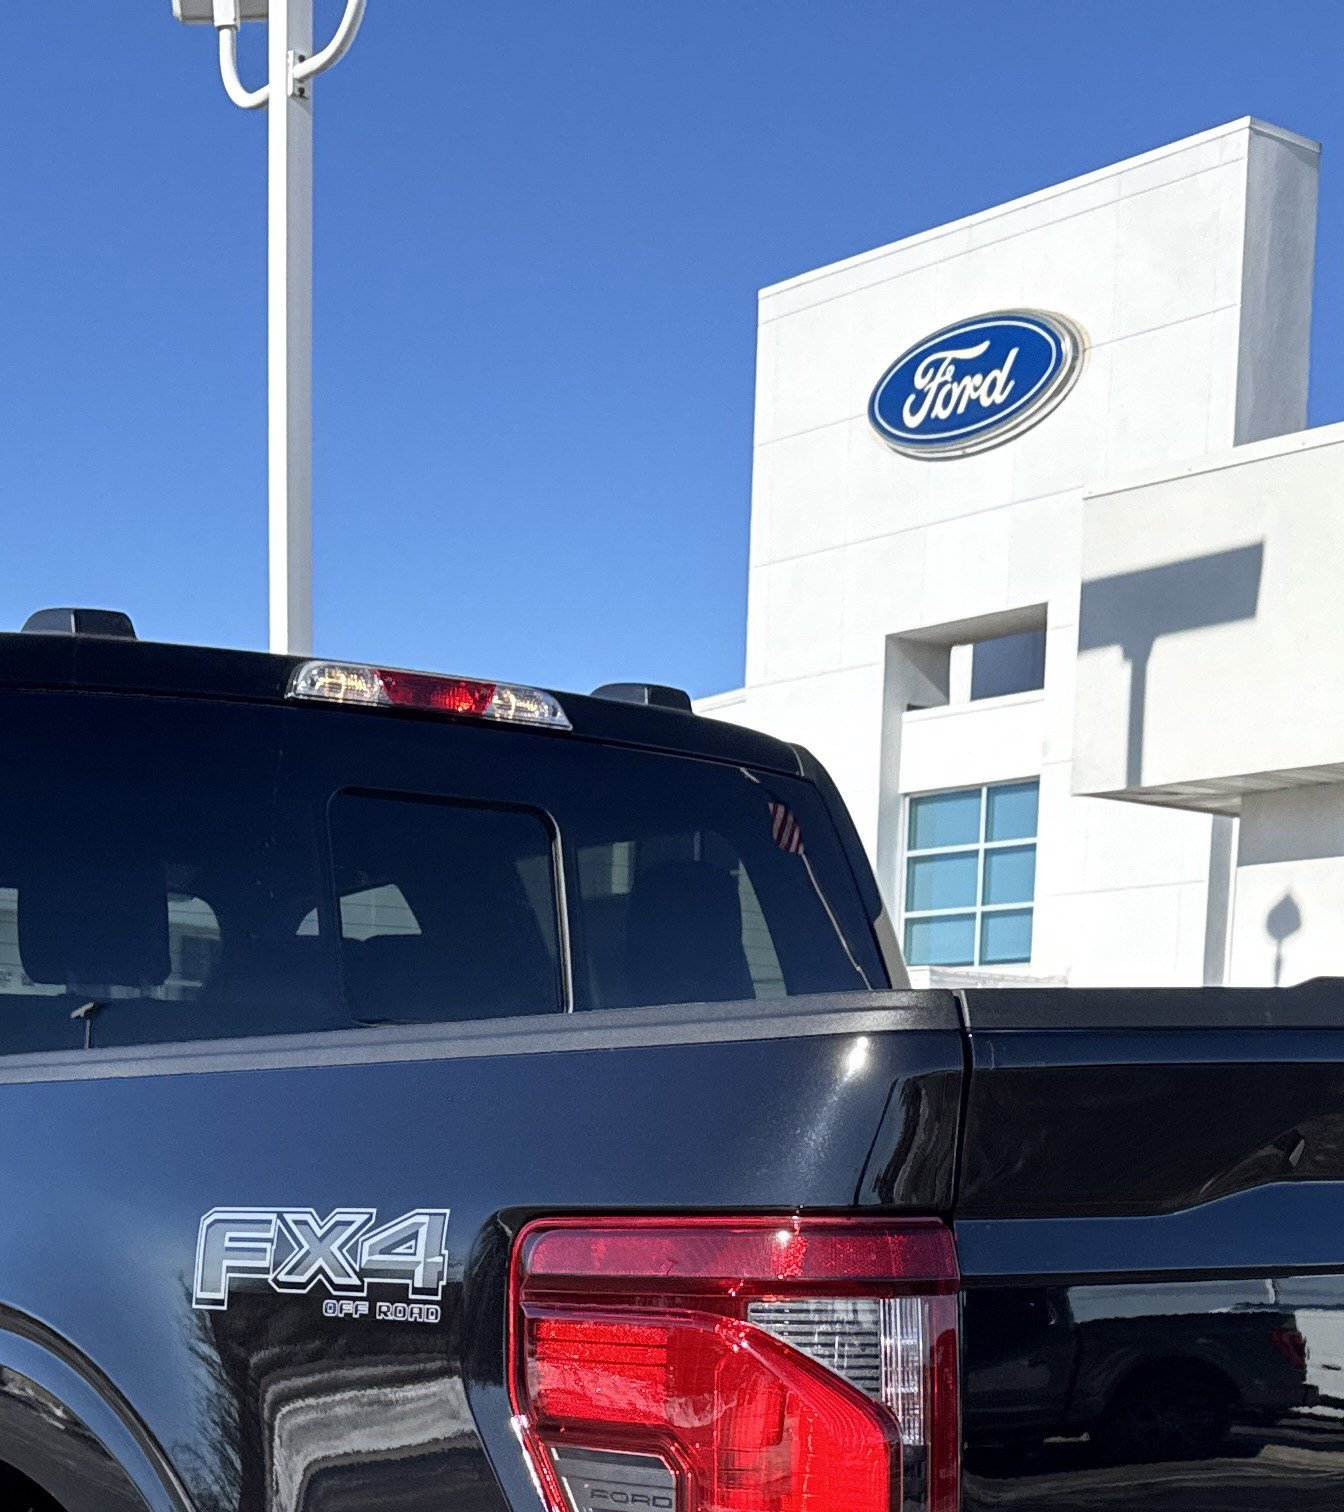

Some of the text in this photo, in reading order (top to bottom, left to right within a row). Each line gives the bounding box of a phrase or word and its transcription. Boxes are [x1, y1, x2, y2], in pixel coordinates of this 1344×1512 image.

[903, 340, 1019, 428] Ford
[192, 1207, 450, 1310] FX4
[322, 1299, 441, 1323] OFF ROAD
[591, 1489, 673, 1509] FORD
